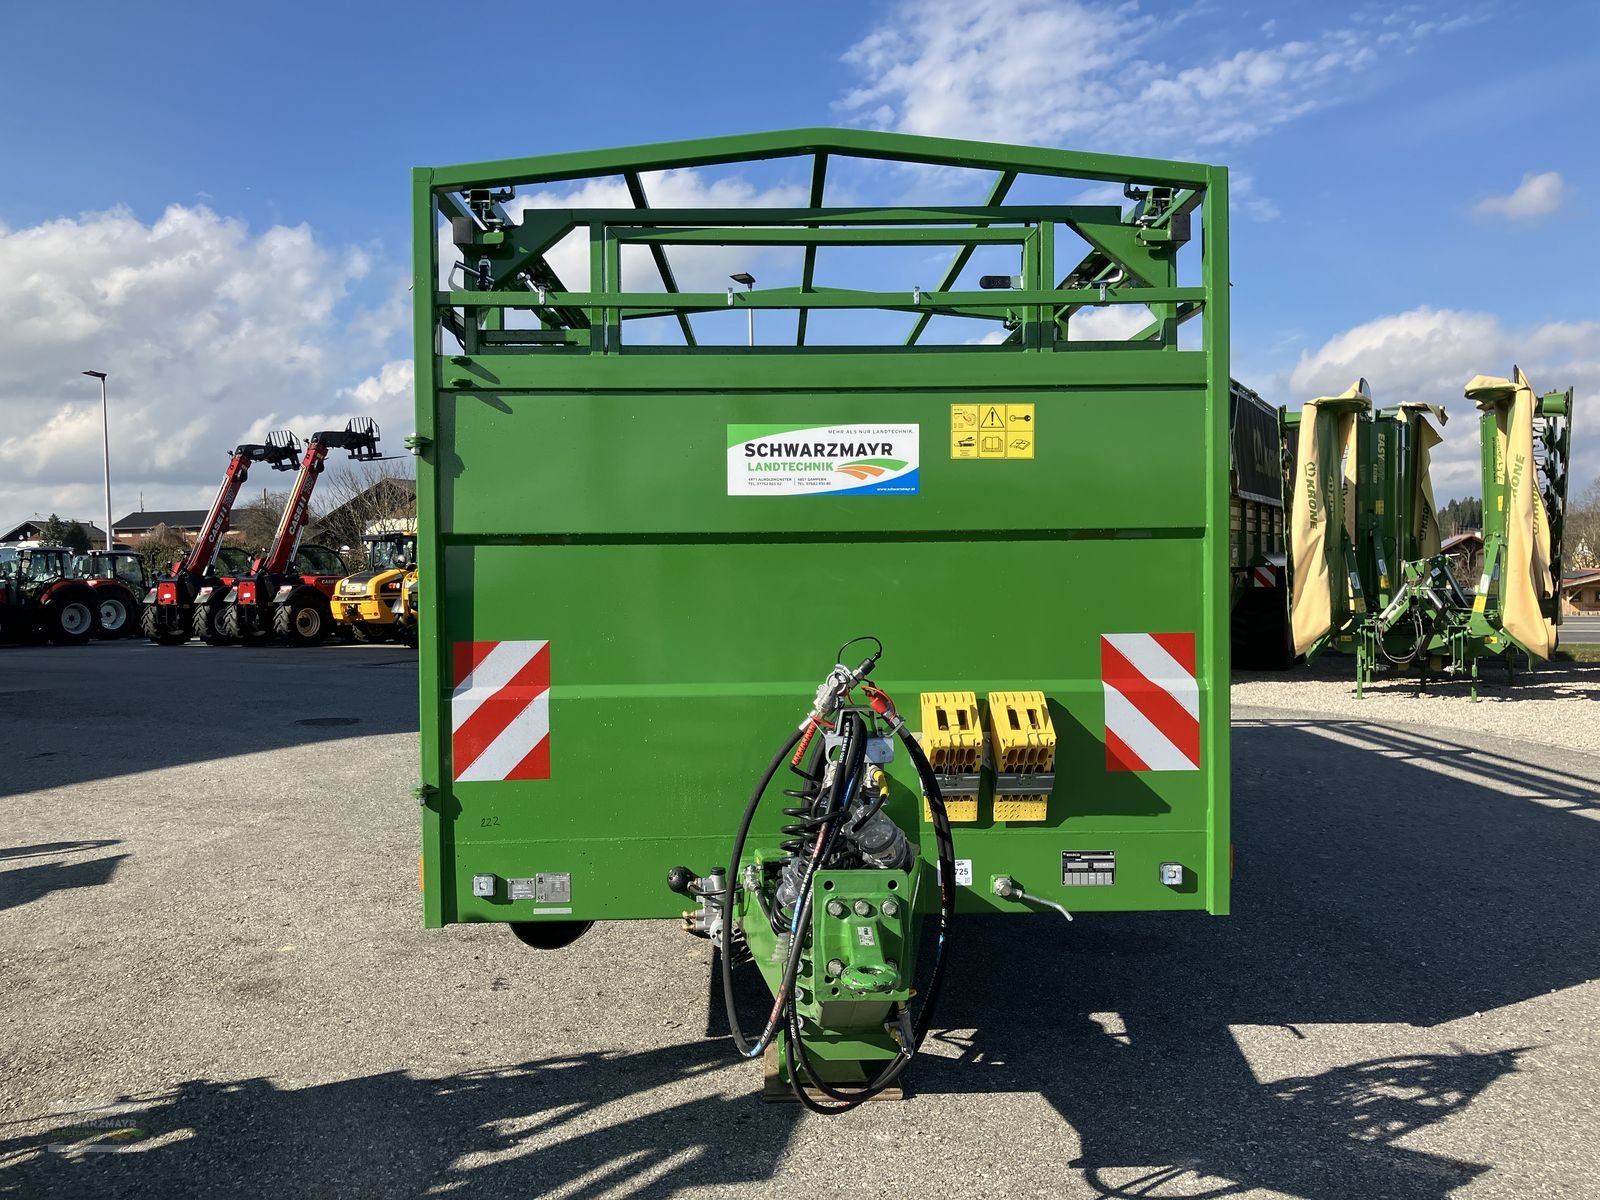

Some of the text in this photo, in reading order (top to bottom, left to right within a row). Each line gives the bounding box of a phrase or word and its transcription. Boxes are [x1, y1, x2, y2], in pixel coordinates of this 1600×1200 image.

[744, 442, 893, 458] SCHWARZMAYR
[747, 462, 834, 472] LANDTECHNIK
[1306, 479, 1318, 530] KRONE
